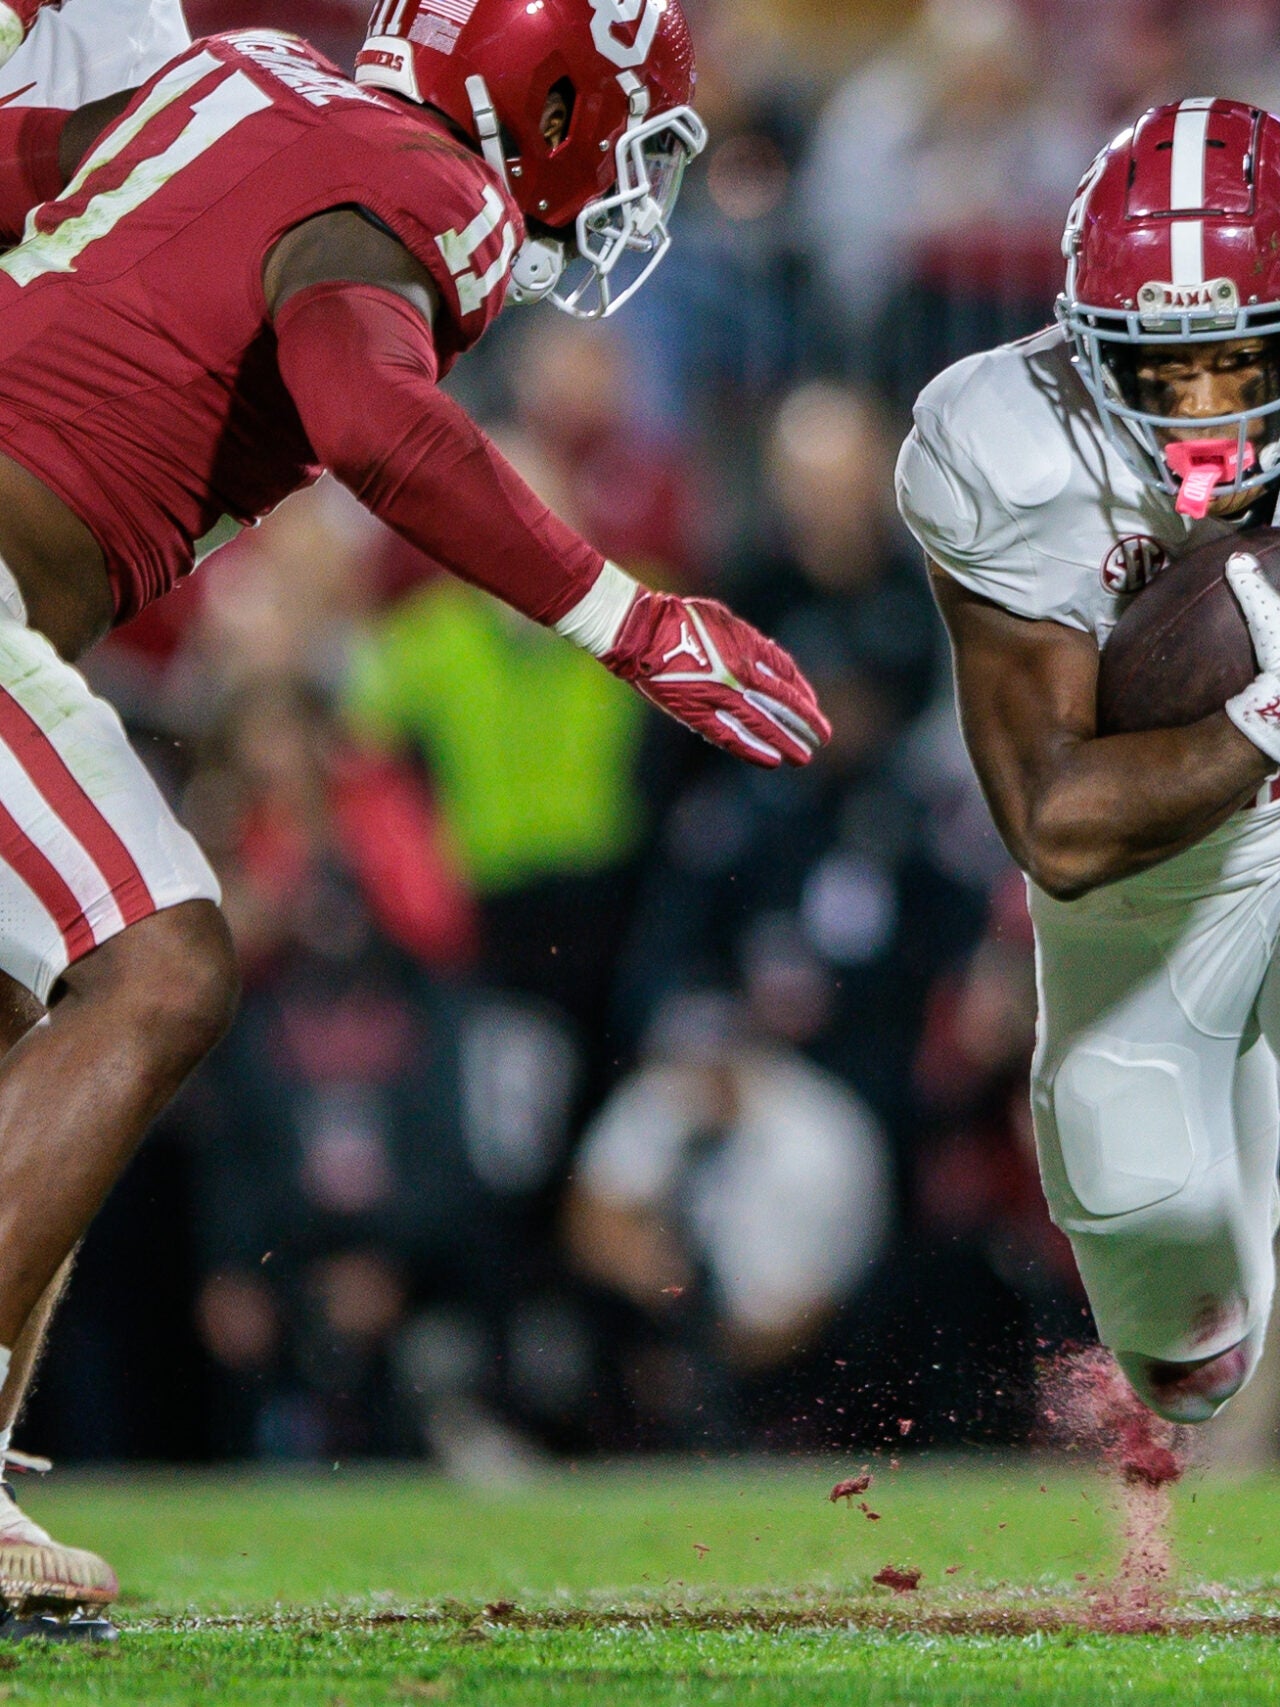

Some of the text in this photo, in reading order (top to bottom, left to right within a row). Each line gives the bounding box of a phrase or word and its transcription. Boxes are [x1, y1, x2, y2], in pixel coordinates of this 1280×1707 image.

[0, 49, 274, 287] 11
[433, 184, 516, 316] 11
[1163, 288, 1213, 307] BAMA
